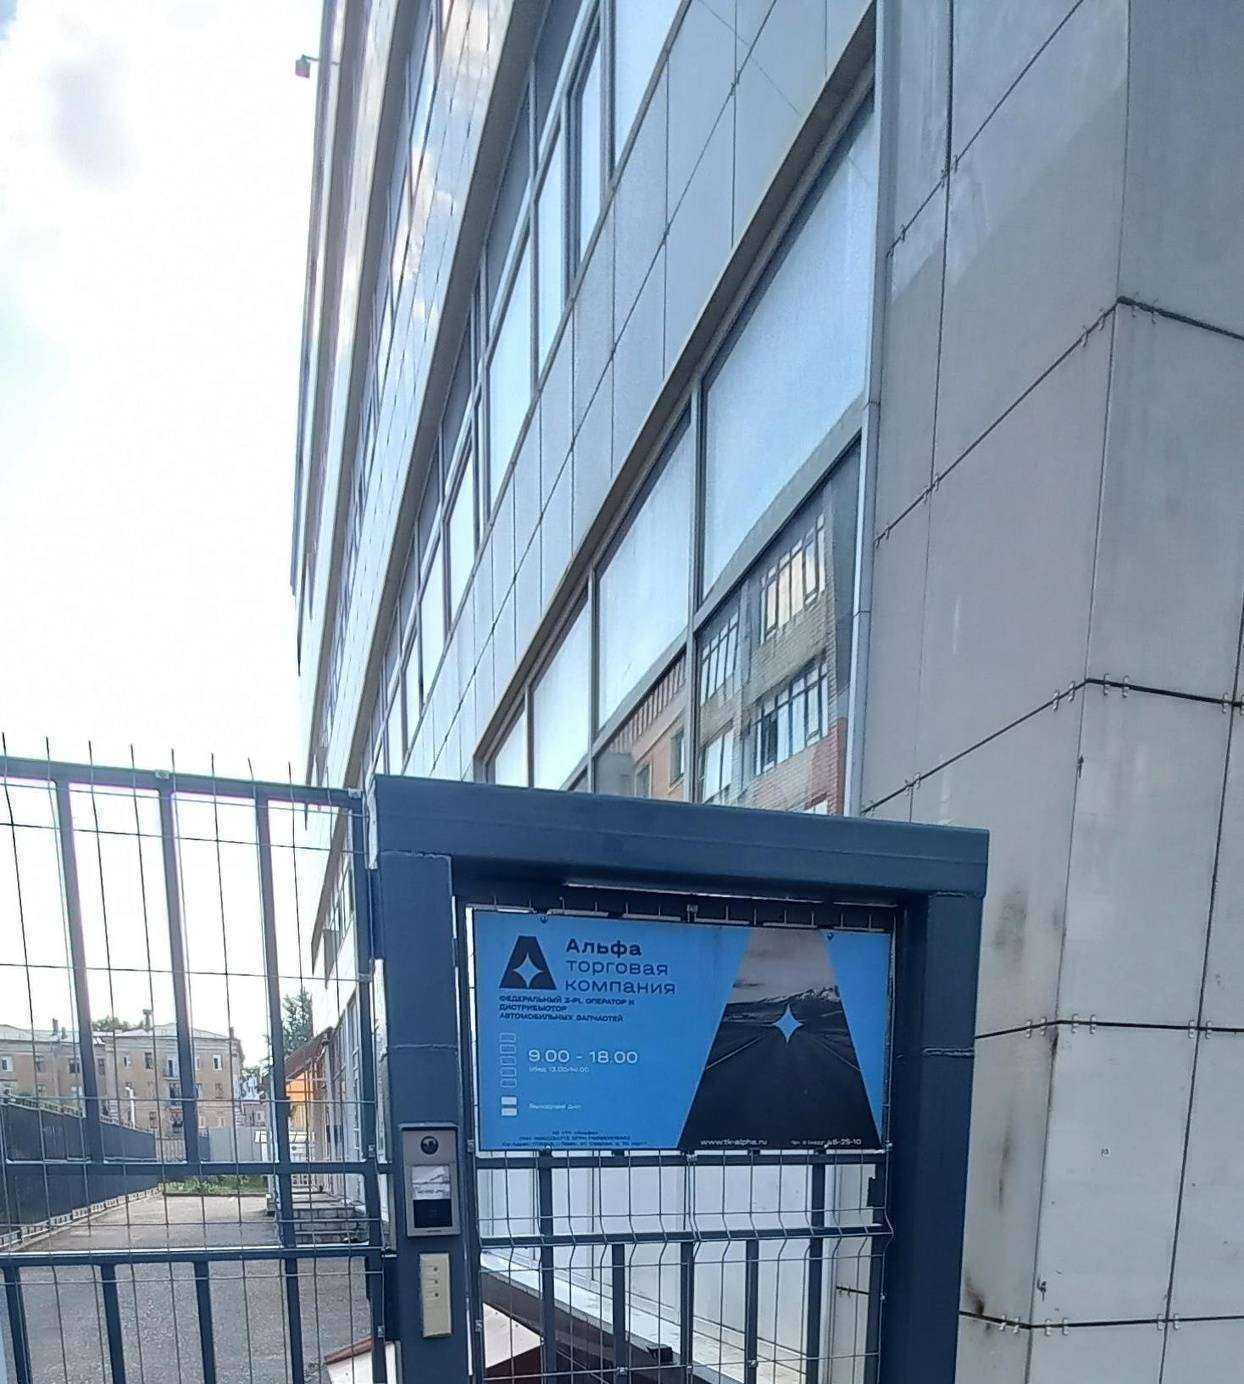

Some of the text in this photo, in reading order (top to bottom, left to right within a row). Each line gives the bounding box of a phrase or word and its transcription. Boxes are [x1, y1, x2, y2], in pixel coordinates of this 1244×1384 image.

[566, 938, 642, 958] Альфа
[566, 960, 668, 976] торговая
[565, 979, 676, 994] компания
